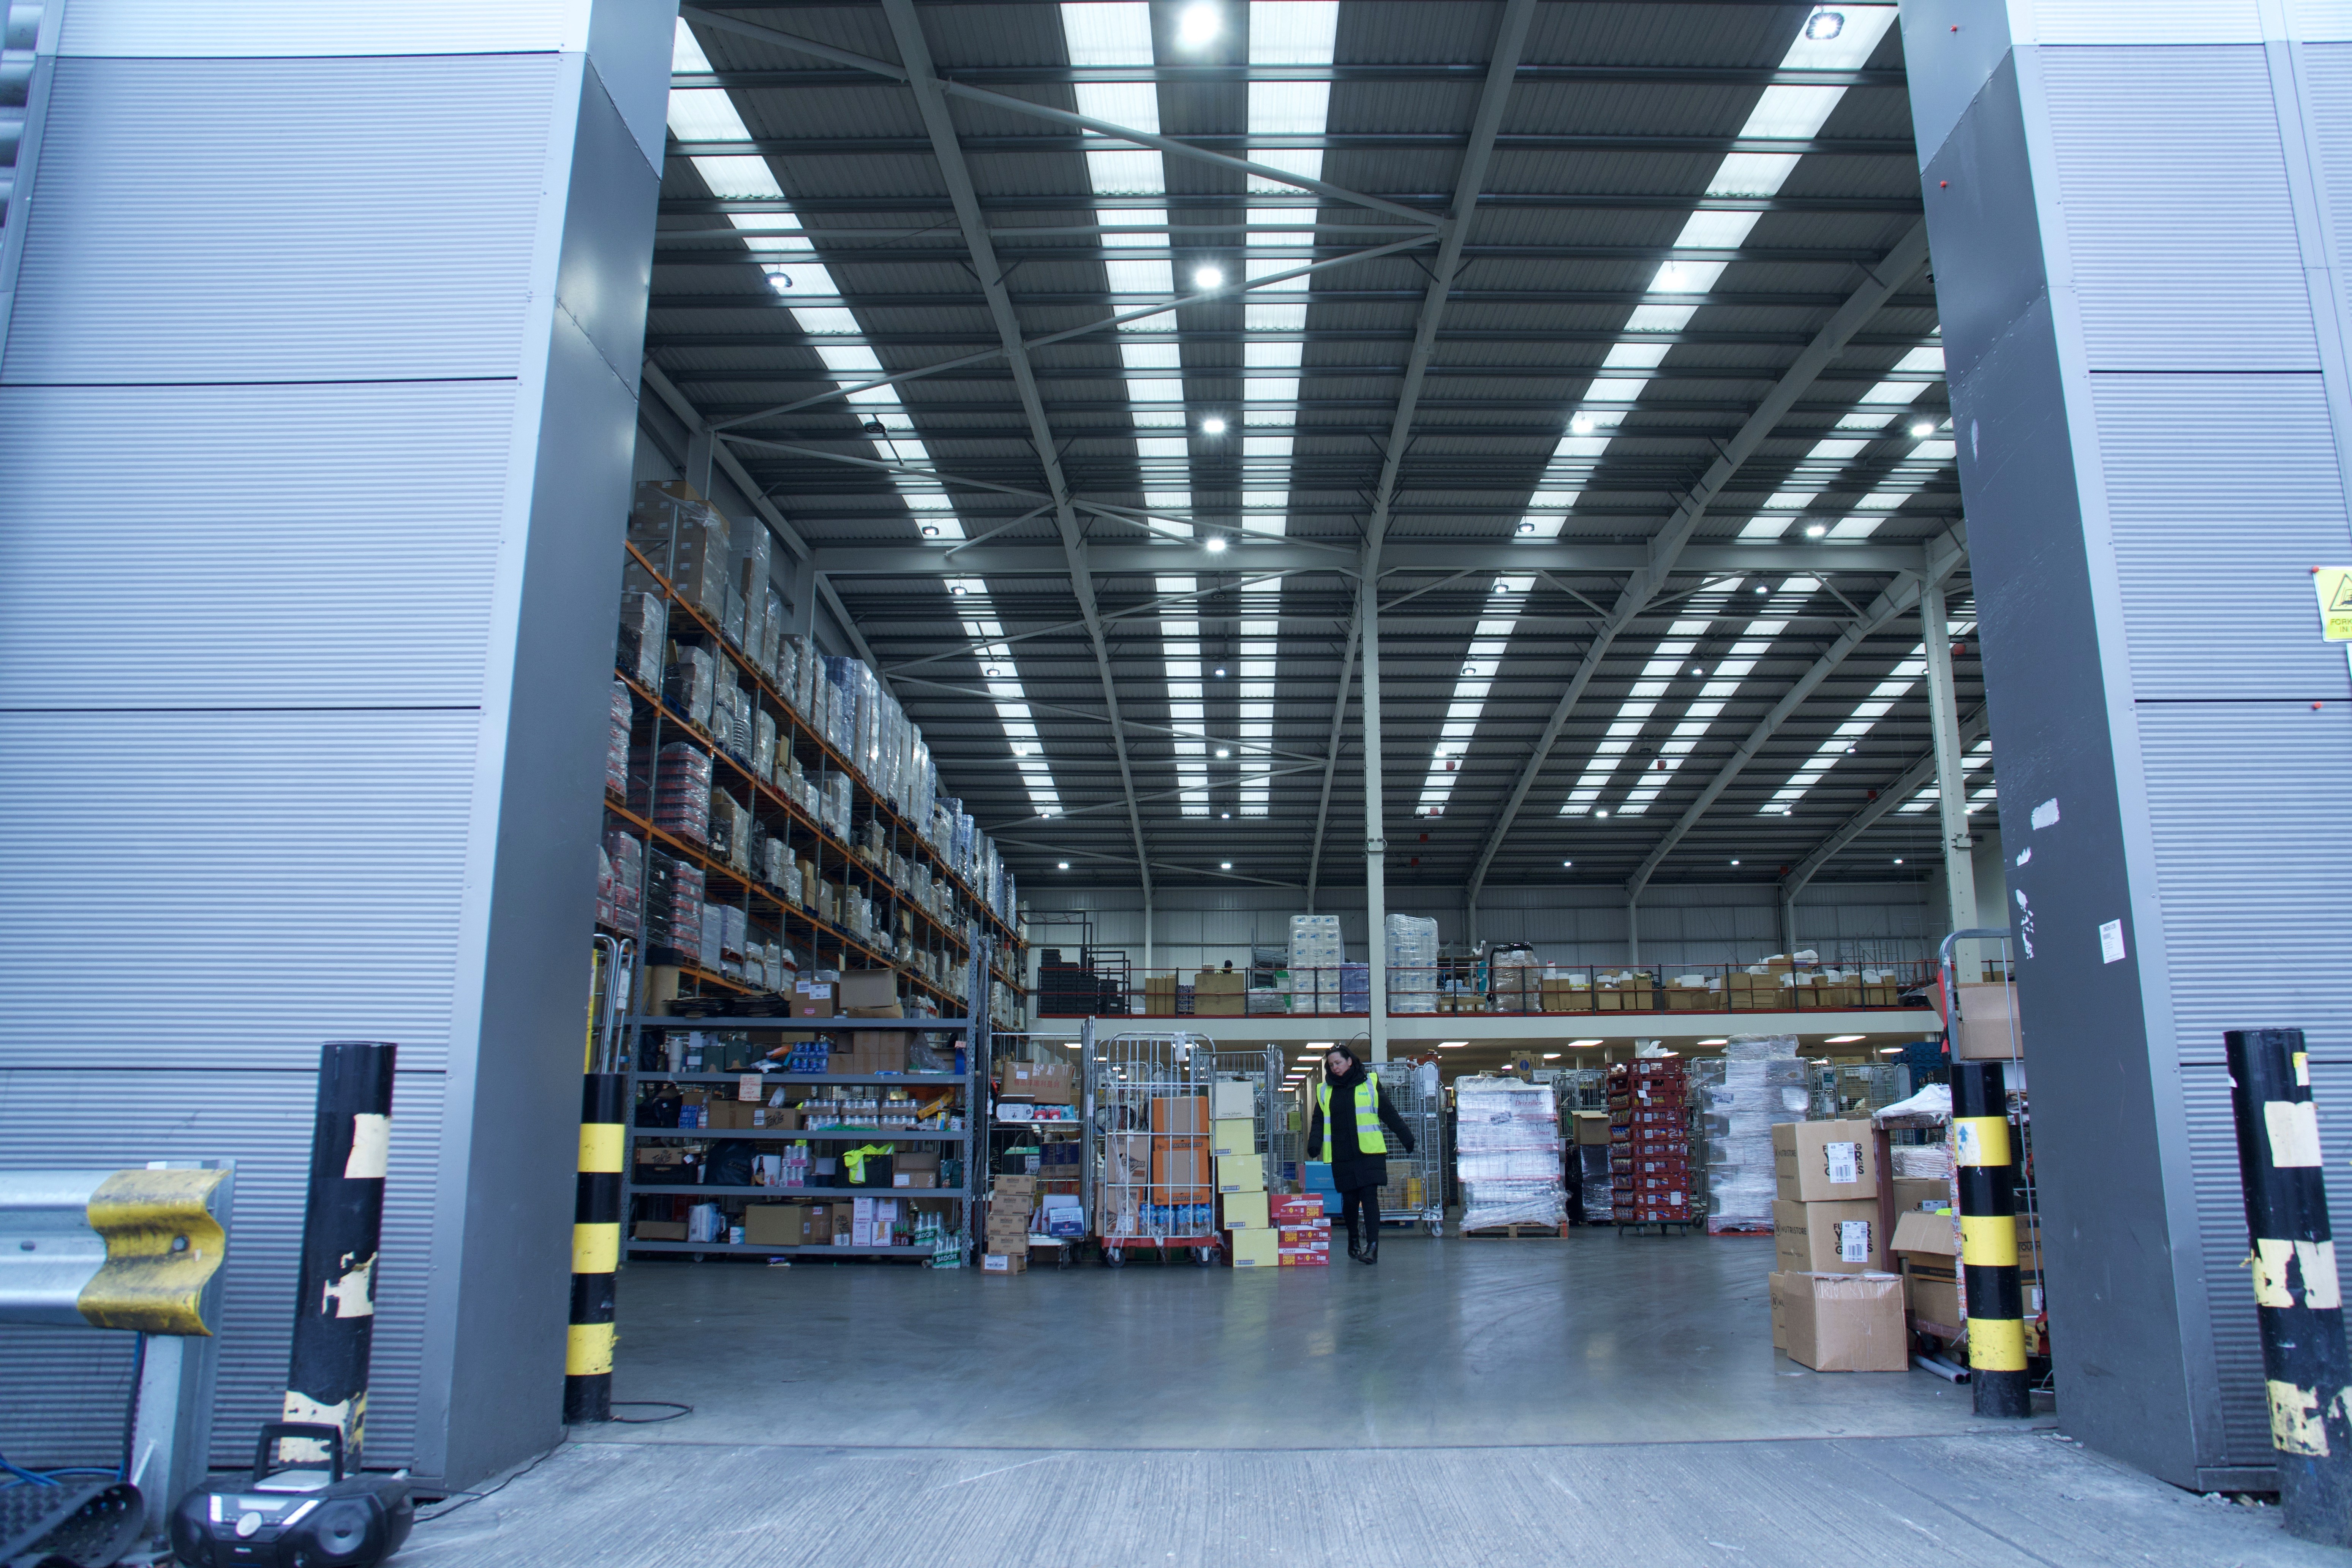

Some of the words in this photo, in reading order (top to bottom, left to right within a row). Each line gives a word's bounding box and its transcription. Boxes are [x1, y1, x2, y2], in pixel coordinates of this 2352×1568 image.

[1122, 1159, 1146, 1168] Dritos
[1781, 1226, 1807, 1235] NUTRISTORE
[936, 1254, 958, 1263] BADOIT
